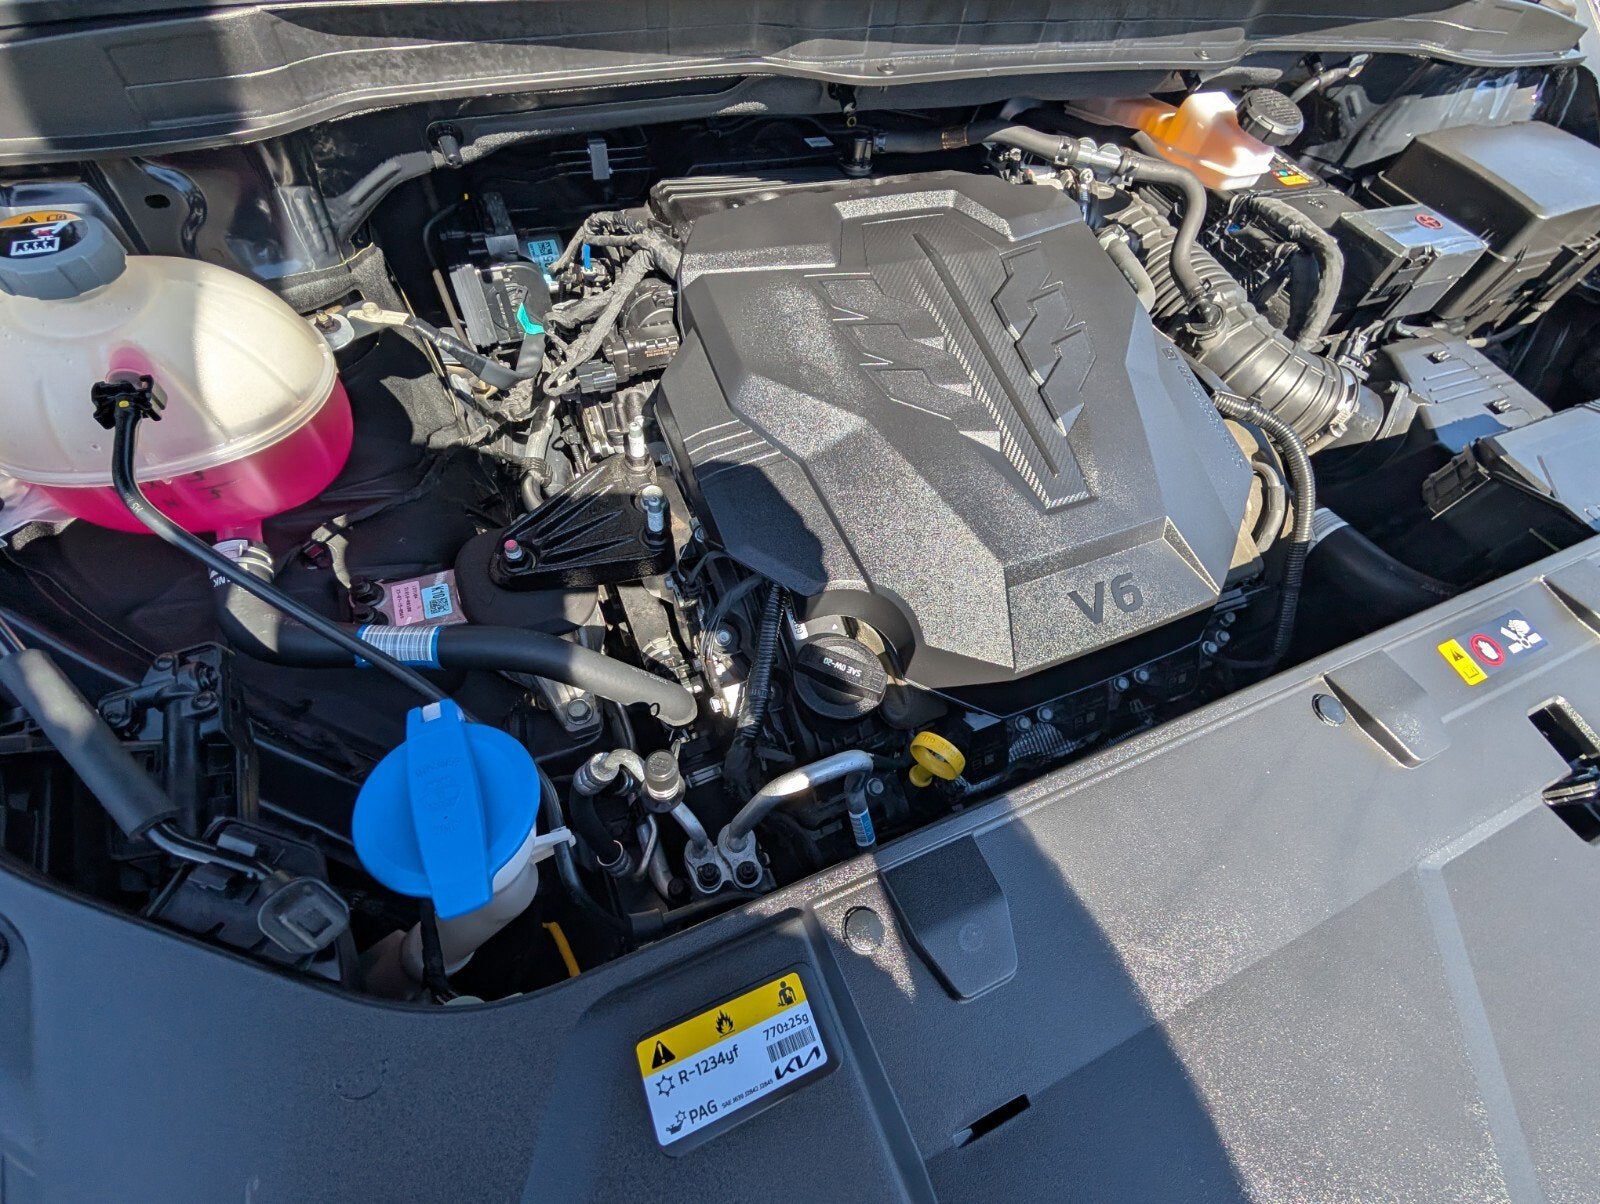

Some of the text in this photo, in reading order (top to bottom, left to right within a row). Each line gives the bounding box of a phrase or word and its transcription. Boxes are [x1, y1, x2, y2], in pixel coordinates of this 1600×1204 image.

[1066, 571, 1143, 625] V6
[822, 656, 862, 677] SAE 0W-20
[762, 1012, 809, 1041] 770±25g
[677, 1043, 740, 1085] R-1234yf
[774, 1045, 821, 1081] KIA
[688, 1099, 719, 1125] PAG
